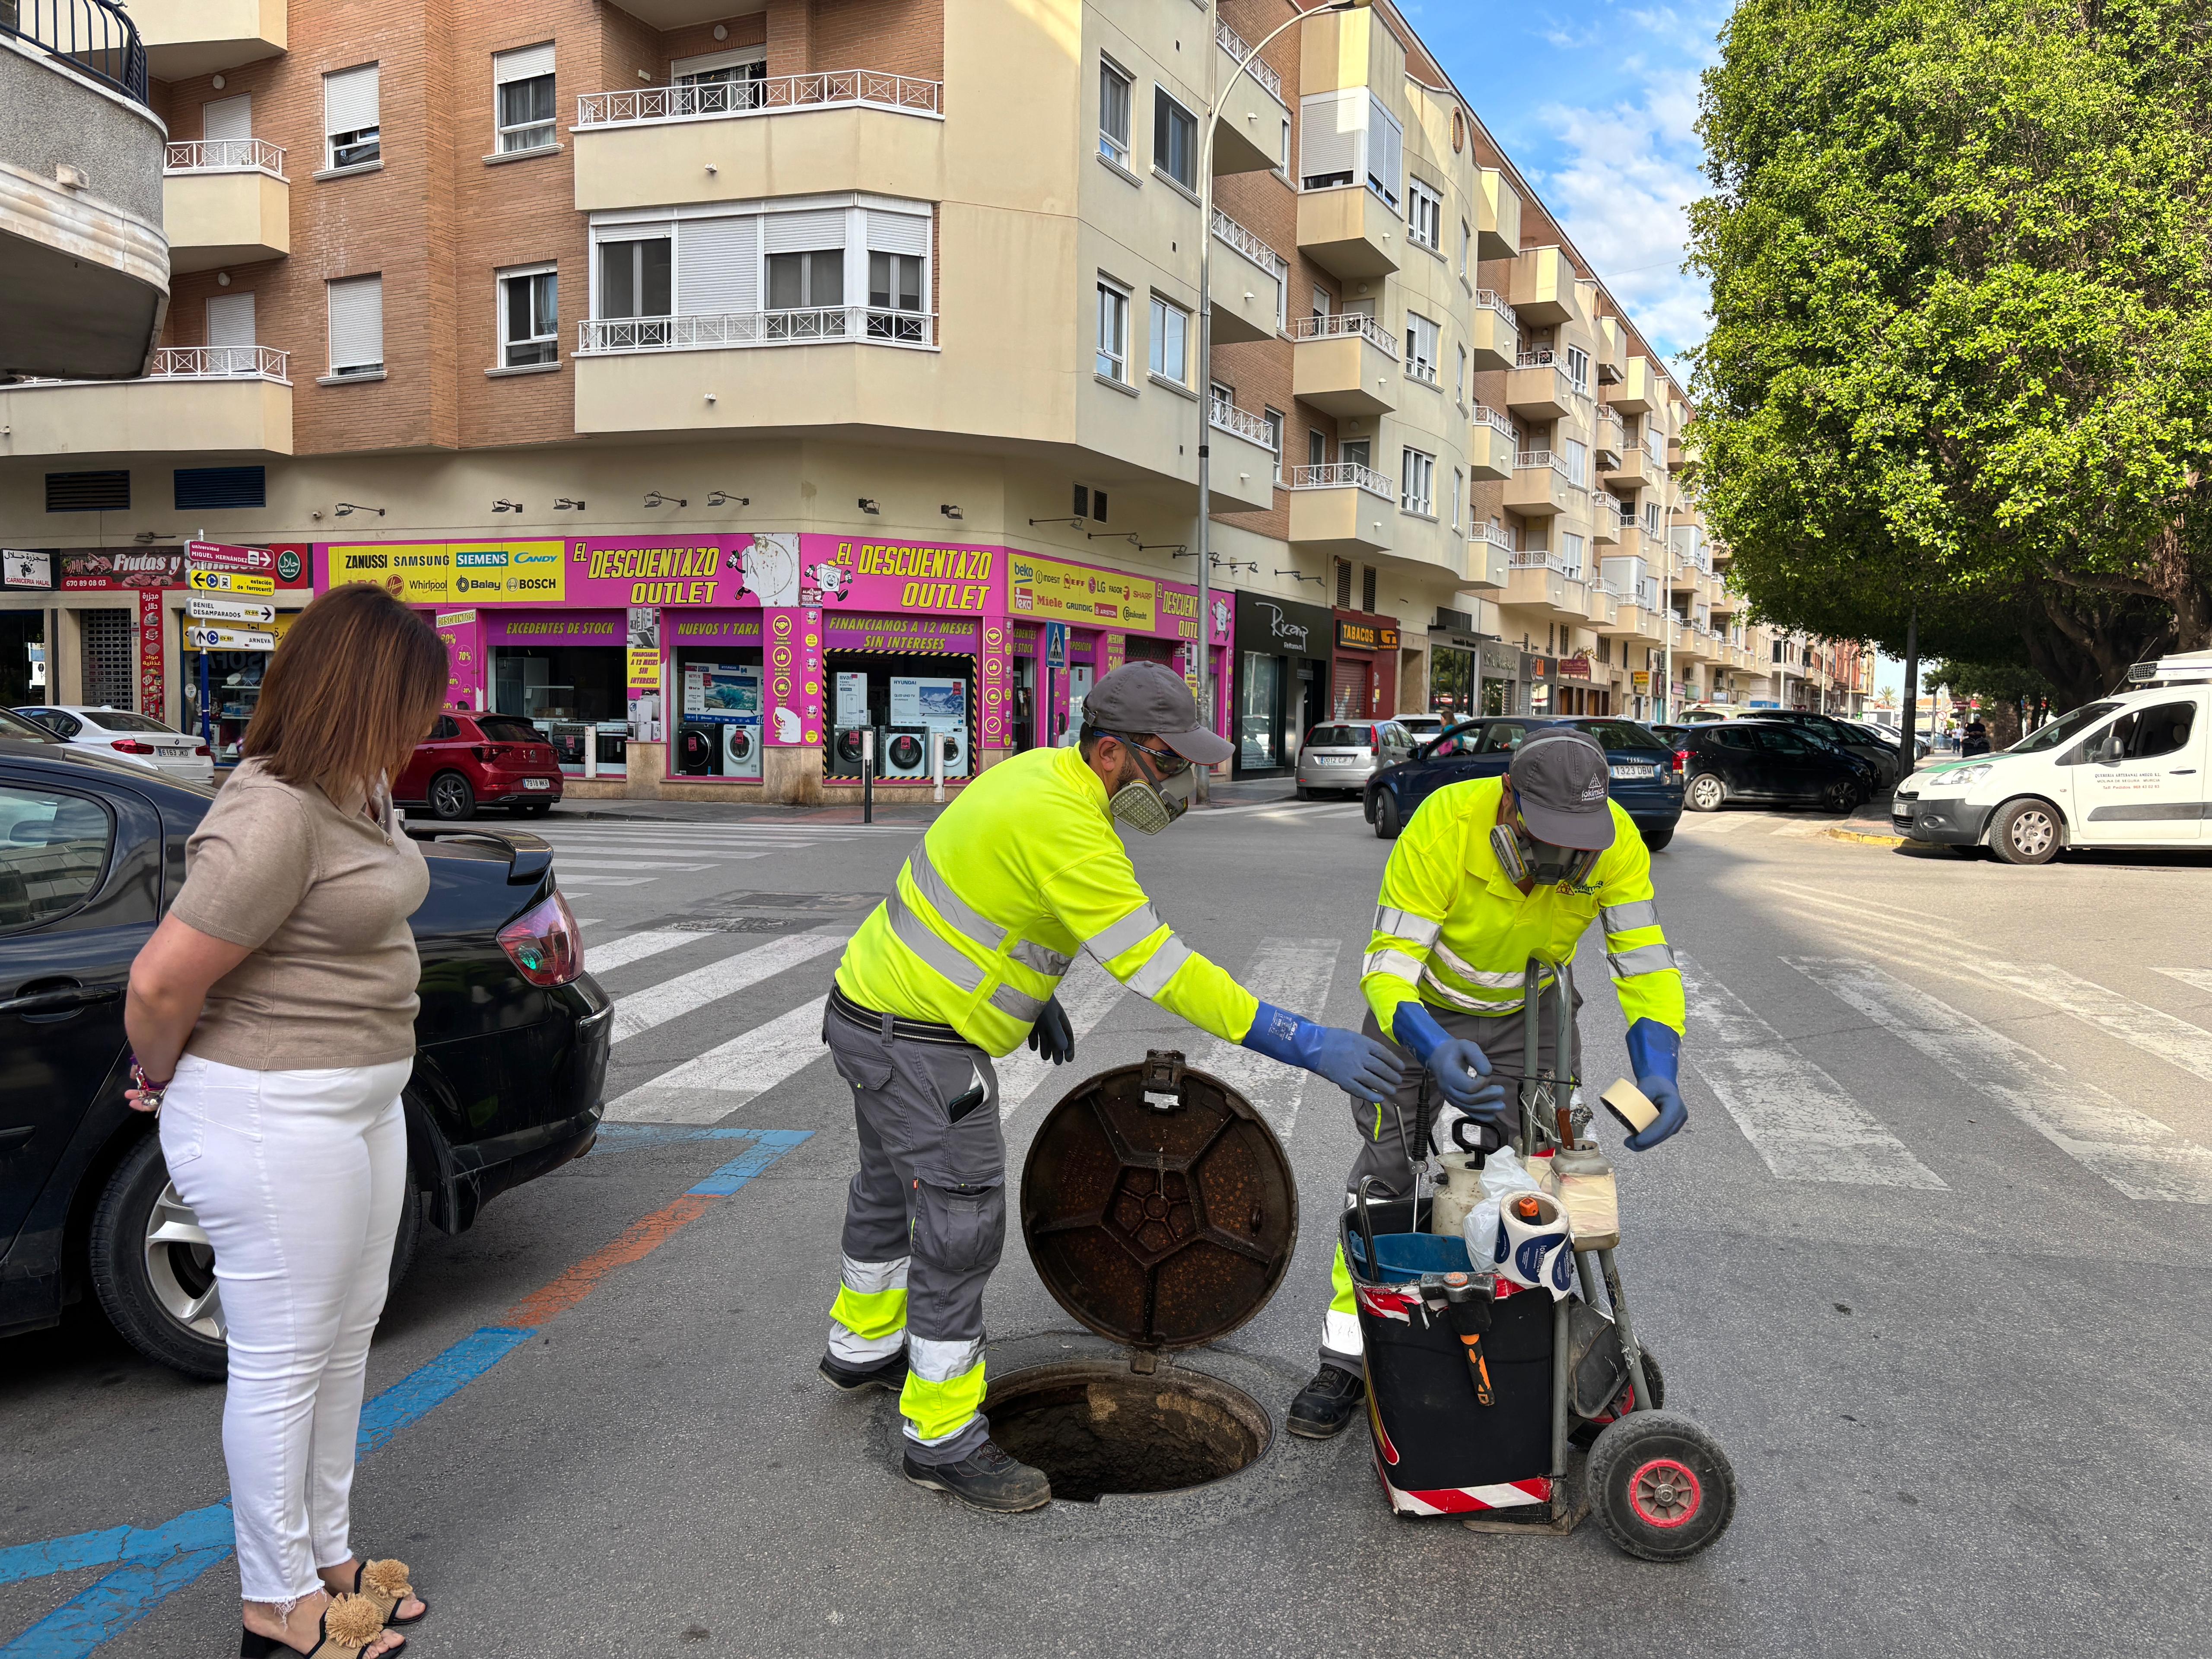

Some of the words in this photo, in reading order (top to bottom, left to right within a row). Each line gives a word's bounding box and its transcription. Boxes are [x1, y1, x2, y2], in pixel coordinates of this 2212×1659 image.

[113, 553, 167, 571] Frutas
[168, 556, 181, 575] y
[216, 555, 248, 563] HERNÁNDEZ
[345, 554, 388, 569] ZANUSSI
[394, 555, 450, 566] SAMSUNG
[457, 554, 507, 565] SIEMENS
[572, 542, 588, 562] EL
[588, 547, 720, 579] DESCUENTAZO
[836, 543, 853, 565] EL
[857, 545, 993, 581] DESCUENTAZO
[409, 580, 447, 592] Whirlpool
[471, 580, 501, 591] Balay
[519, 578, 556, 589] BOSCH
[1015, 562, 1033, 577] beko
[1097, 581, 1106, 593] LG
[1109, 585, 1122, 594] FAGOR
[1133, 591, 1152, 600] SHARP
[630, 582, 719, 604] OUTLET
[902, 582, 991, 610] OUTLET
[1037, 595, 1062, 608] Miele
[1066, 602, 1093, 612] GRUNDIG
[1157, 582, 1163, 599] EL
[1162, 590, 1198, 619] DESCUENT
[193, 609, 241, 618] DESAMPARADOS
[506, 623, 564, 634] EXCEDENTES
[567, 623, 579, 634] DE
[582, 623, 615, 634] STOCK
[677, 623, 719, 635] NUEVOS
[722, 623, 730, 635] Y
[733, 623, 759, 635] TARA
[829, 617, 908, 632] FINANCIAMOS
[910, 621, 918, 632] A
[923, 622, 936, 633] 12
[940, 623, 975, 635] MESES
[1178, 620, 1198, 639] OUTL
[1014, 629, 1036, 640] CEDENTES
[1343, 624, 1374, 643] TABACOS
[864, 636, 884, 648] SIN
[887, 637, 946, 650] INTERESES
[1018, 643, 1033, 653] STOCK
[1071, 641, 1092, 651] XPOSICION
[458, 651, 471, 661] 70%
[1616, 766, 1635, 775] 1323
[1637, 766, 1652, 775] DBM
